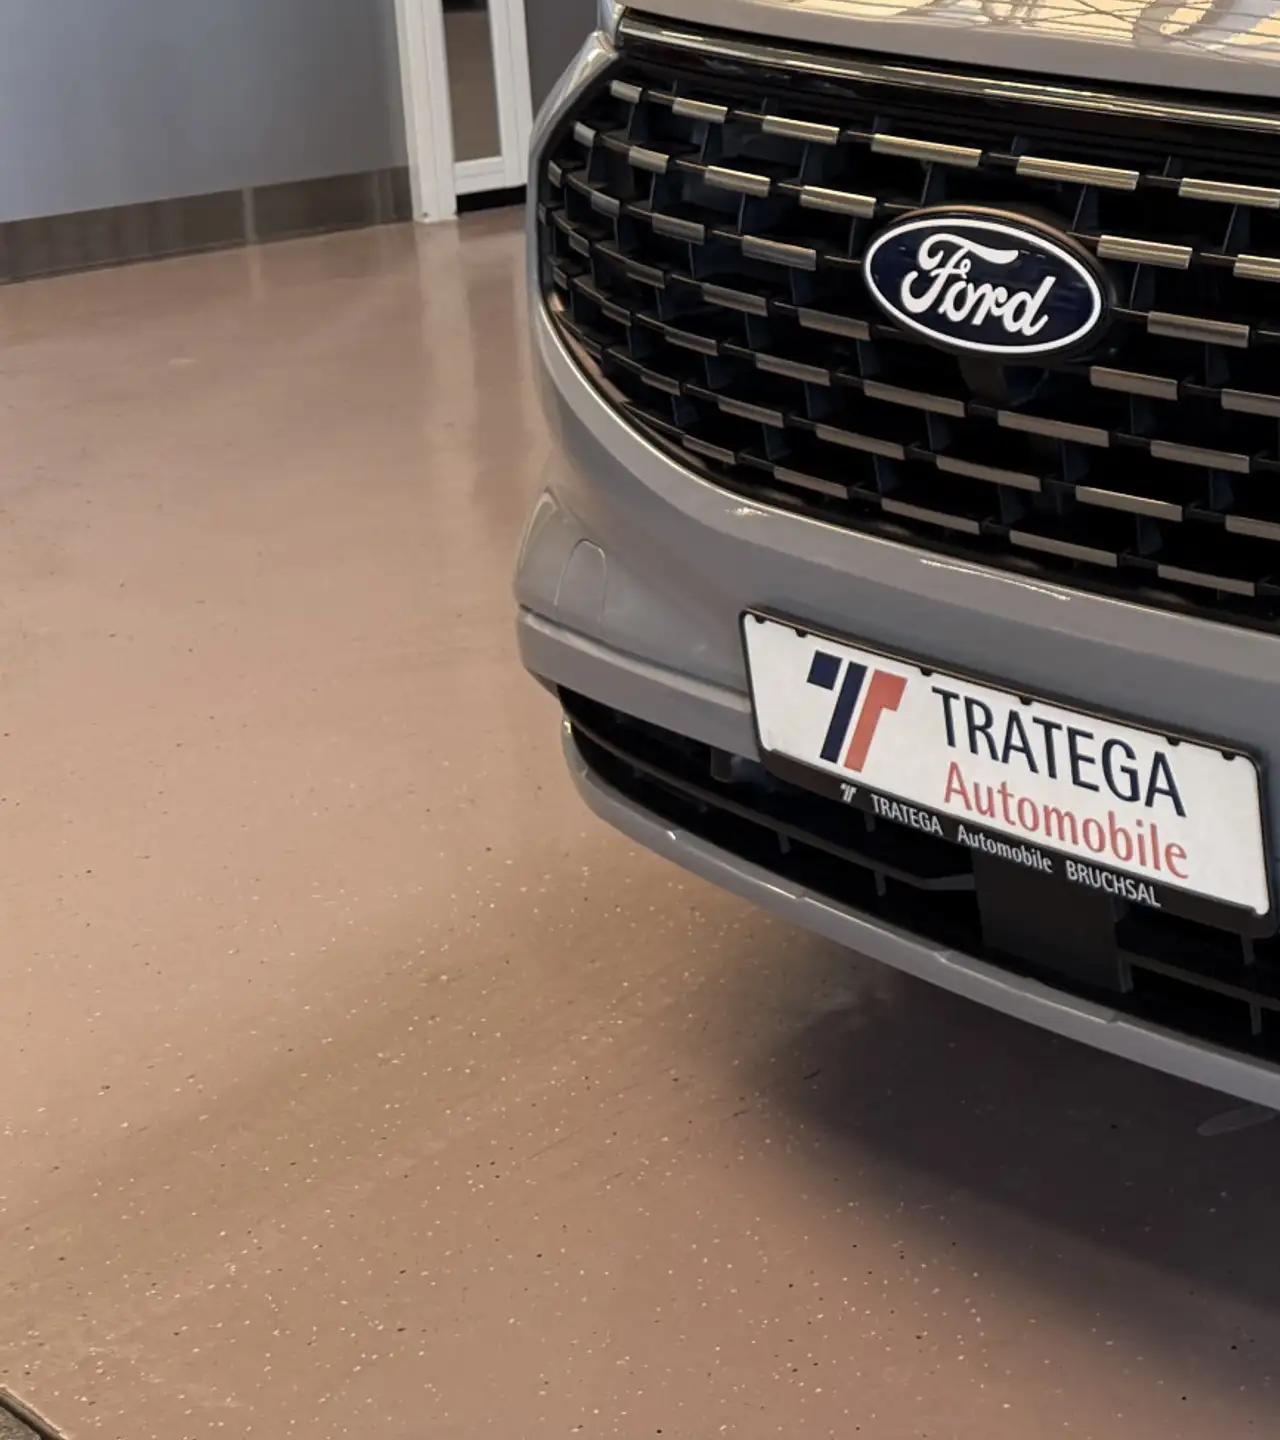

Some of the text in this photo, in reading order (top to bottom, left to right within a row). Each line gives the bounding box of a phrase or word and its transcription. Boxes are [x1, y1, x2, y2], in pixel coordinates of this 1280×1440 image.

[901, 233, 1056, 336] Ford
[932, 686, 1187, 818] TRATEGA
[871, 793, 1161, 908] TRATEGA Automobile BRUCHSAL
[945, 762, 1187, 880] Automobile
